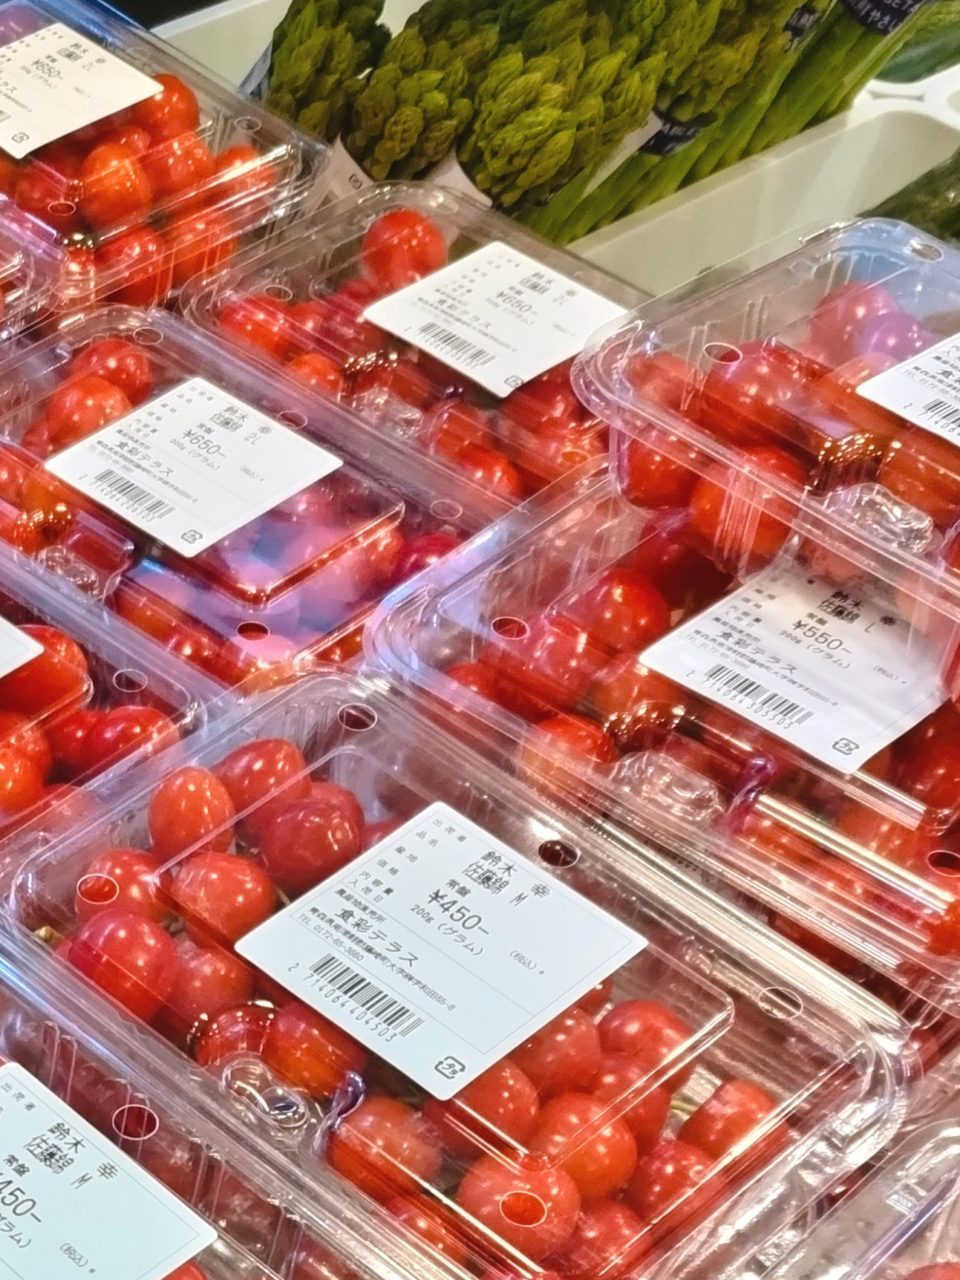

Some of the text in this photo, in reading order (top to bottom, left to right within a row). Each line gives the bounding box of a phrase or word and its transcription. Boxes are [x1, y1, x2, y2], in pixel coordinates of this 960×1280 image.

[181, 428, 226, 457] ¥650-
[792, 619, 852, 654] ¥550-
[862, 622, 881, 634] L
[414, 831, 530, 907] 品名 佐藤錦 M
[431, 819, 552, 898] 出荷者 鈴木 幸
[346, 878, 383, 903] 入荷日
[358, 871, 394, 896] 内容量
[375, 858, 400, 876] 価格
[426, 888, 490, 934] ¥450-
[444, 878, 471, 898] 常盤
[297, 913, 312, 926] TEL
[333, 908, 419, 967] 食彩テラス
[288, 961, 301, 971] 2
[1, 1082, 118, 1180] 出荷者 鈴木 幸
[2, 1154, 30, 1178] 常盤
[22, 1133, 75, 1174] 佐藤錦
[69, 1172, 93, 1189] M
